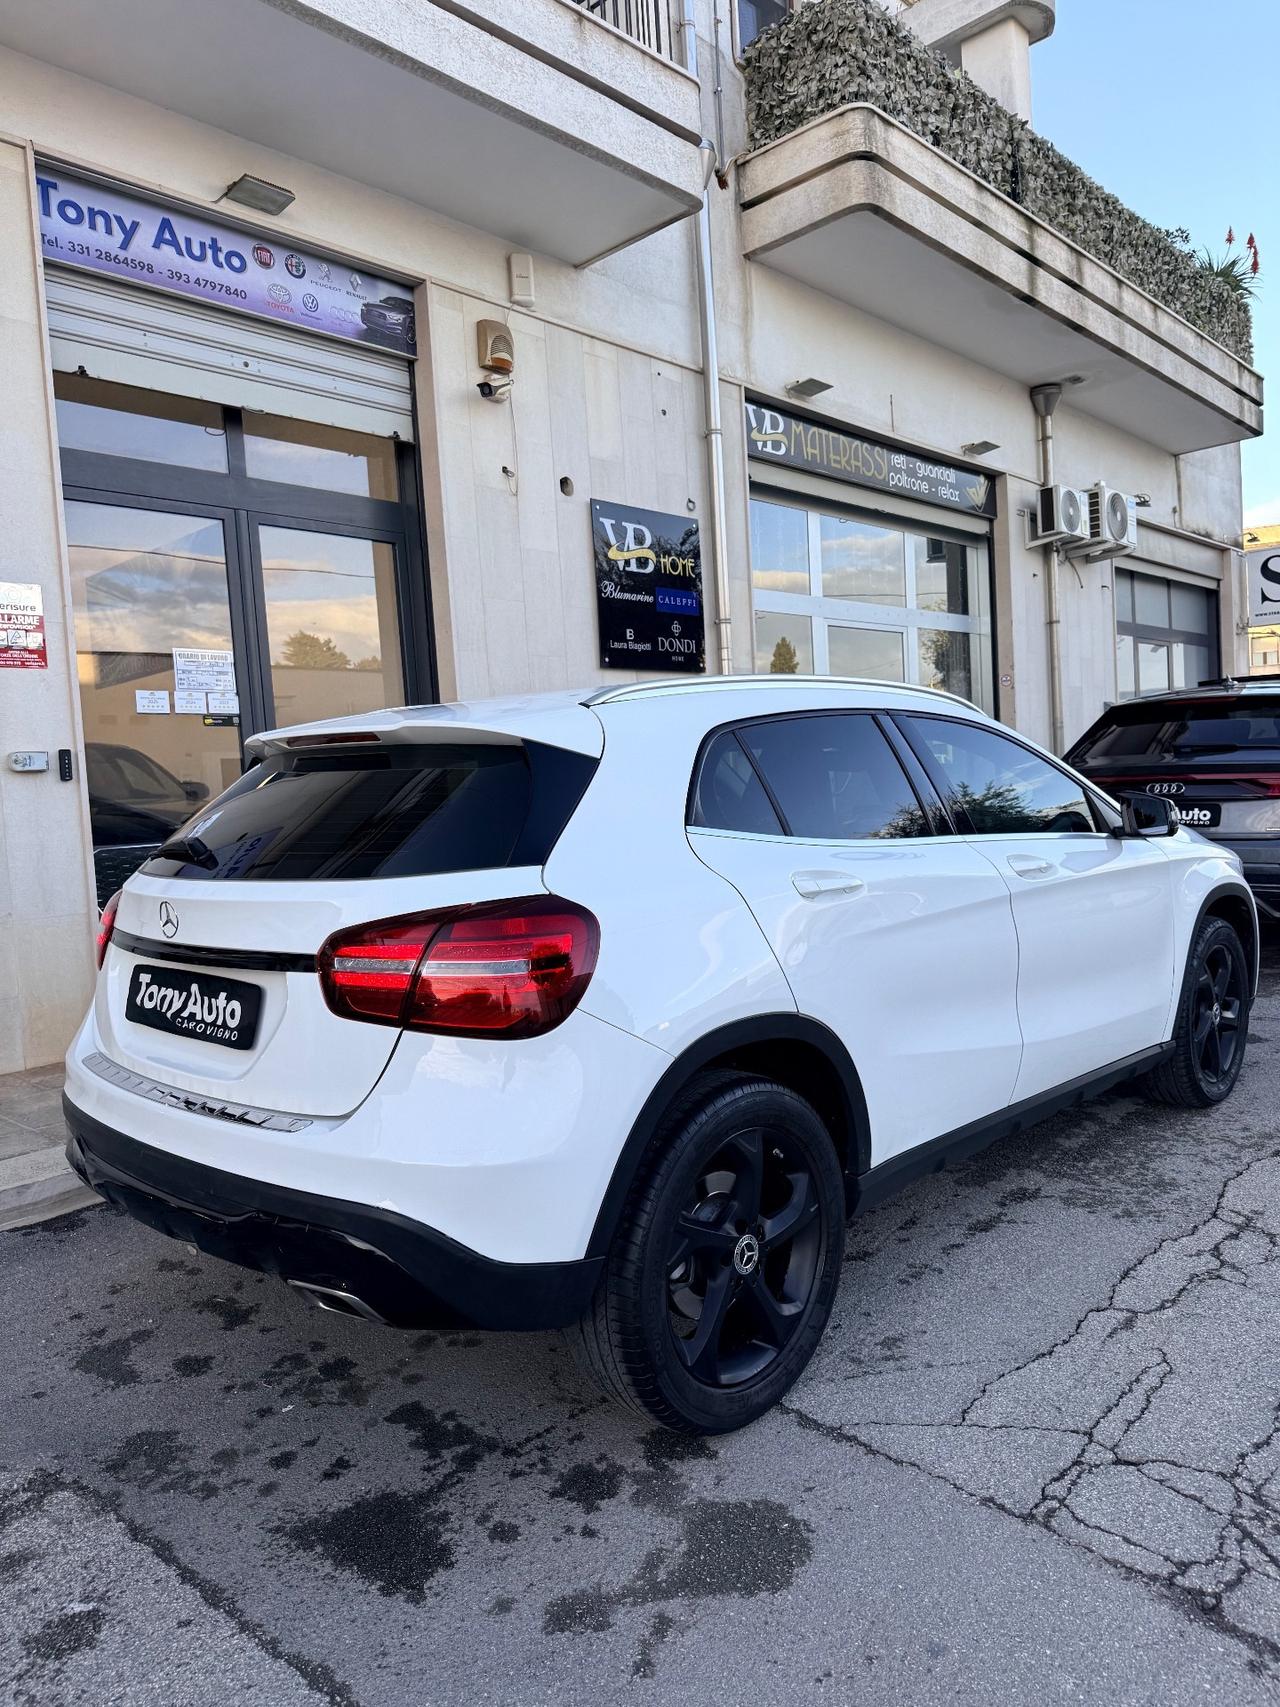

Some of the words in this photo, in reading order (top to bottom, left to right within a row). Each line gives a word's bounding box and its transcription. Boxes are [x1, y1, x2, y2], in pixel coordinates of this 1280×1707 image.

[36, 177, 140, 251] Tony
[152, 217, 248, 274] Auto
[41, 233, 64, 250] Tel.
[68, 241, 91, 257] 331
[95, 248, 155, 274] 2864598
[167, 269, 191, 284] 393
[193, 277, 248, 300] 4797840
[310, 279, 342, 293] PEUGEOT
[346, 290, 368, 300] RENAULT
[266, 301, 295, 313] TOYOTA
[790, 420, 889, 481] MATERASSI
[890, 453, 907, 470] reti
[916, 462, 956, 484] guanciali
[889, 472, 929, 494] poltrone
[937, 485, 960, 502] relax
[660, 553, 696, 578] HOME
[601, 581, 655, 604] Blumarine
[658, 595, 697, 608] CALEFFI
[0, 603, 36, 612] erisure
[610, 640, 628, 650] Laura
[628, 641, 652, 652] Biagiotti
[658, 637, 697, 654] DONDI
[175, 1018, 238, 1041] CAROVIGNO
